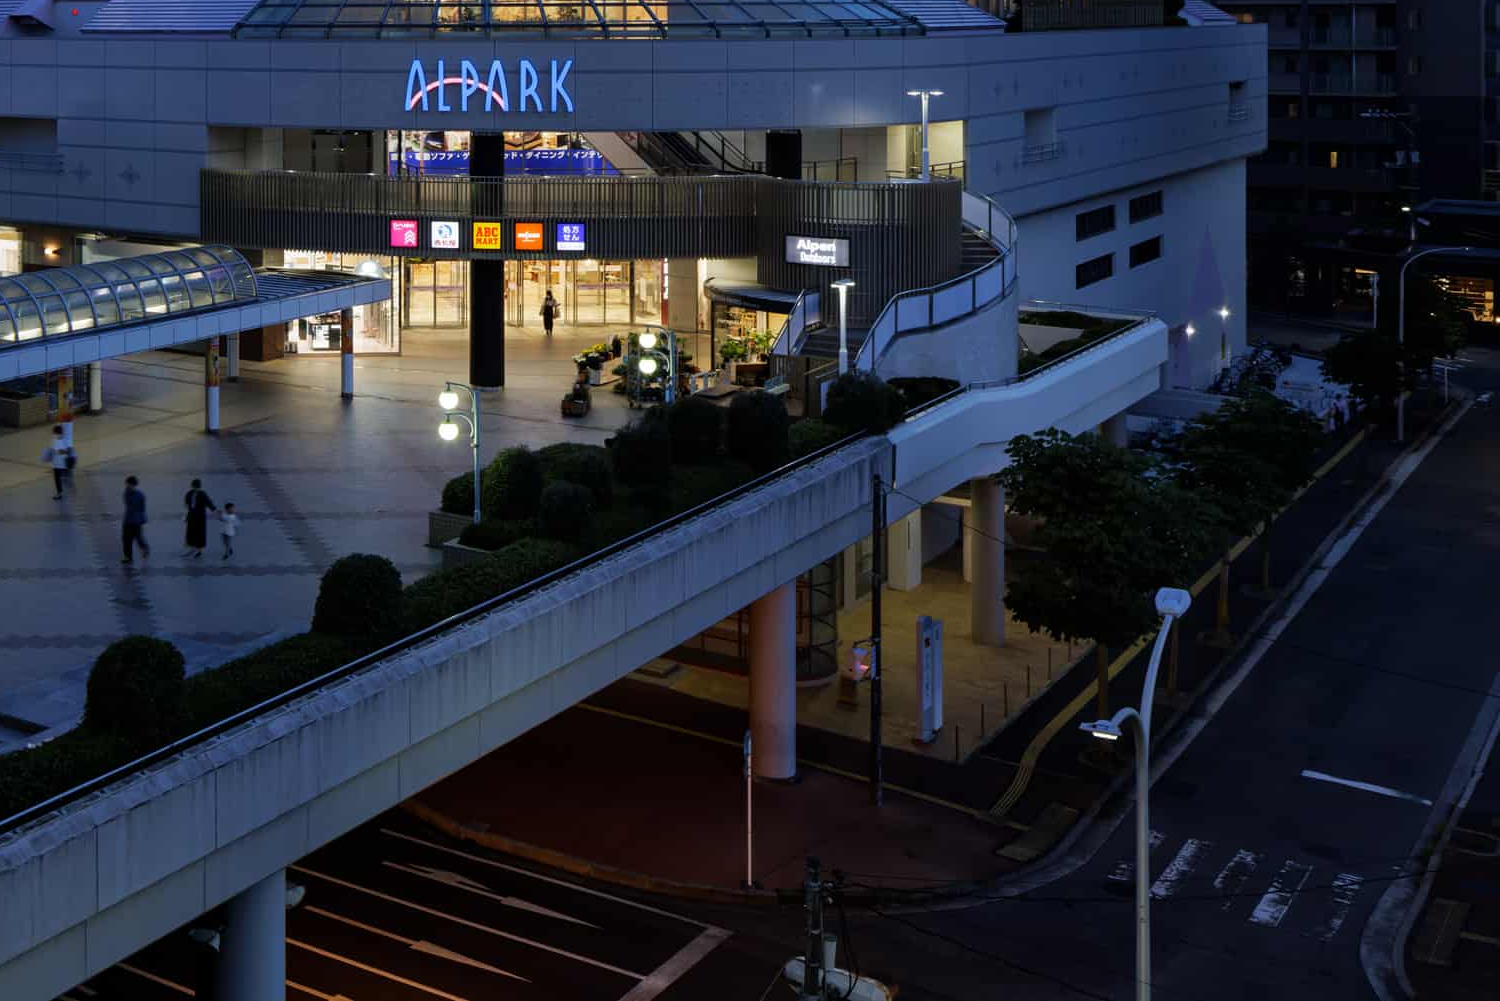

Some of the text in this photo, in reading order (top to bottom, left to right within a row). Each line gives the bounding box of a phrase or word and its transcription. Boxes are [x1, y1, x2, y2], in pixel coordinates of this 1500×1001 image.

[404, 59, 575, 112] ALPARK
[475, 226, 498, 237] ABC
[796, 239, 836, 254] Alpen
